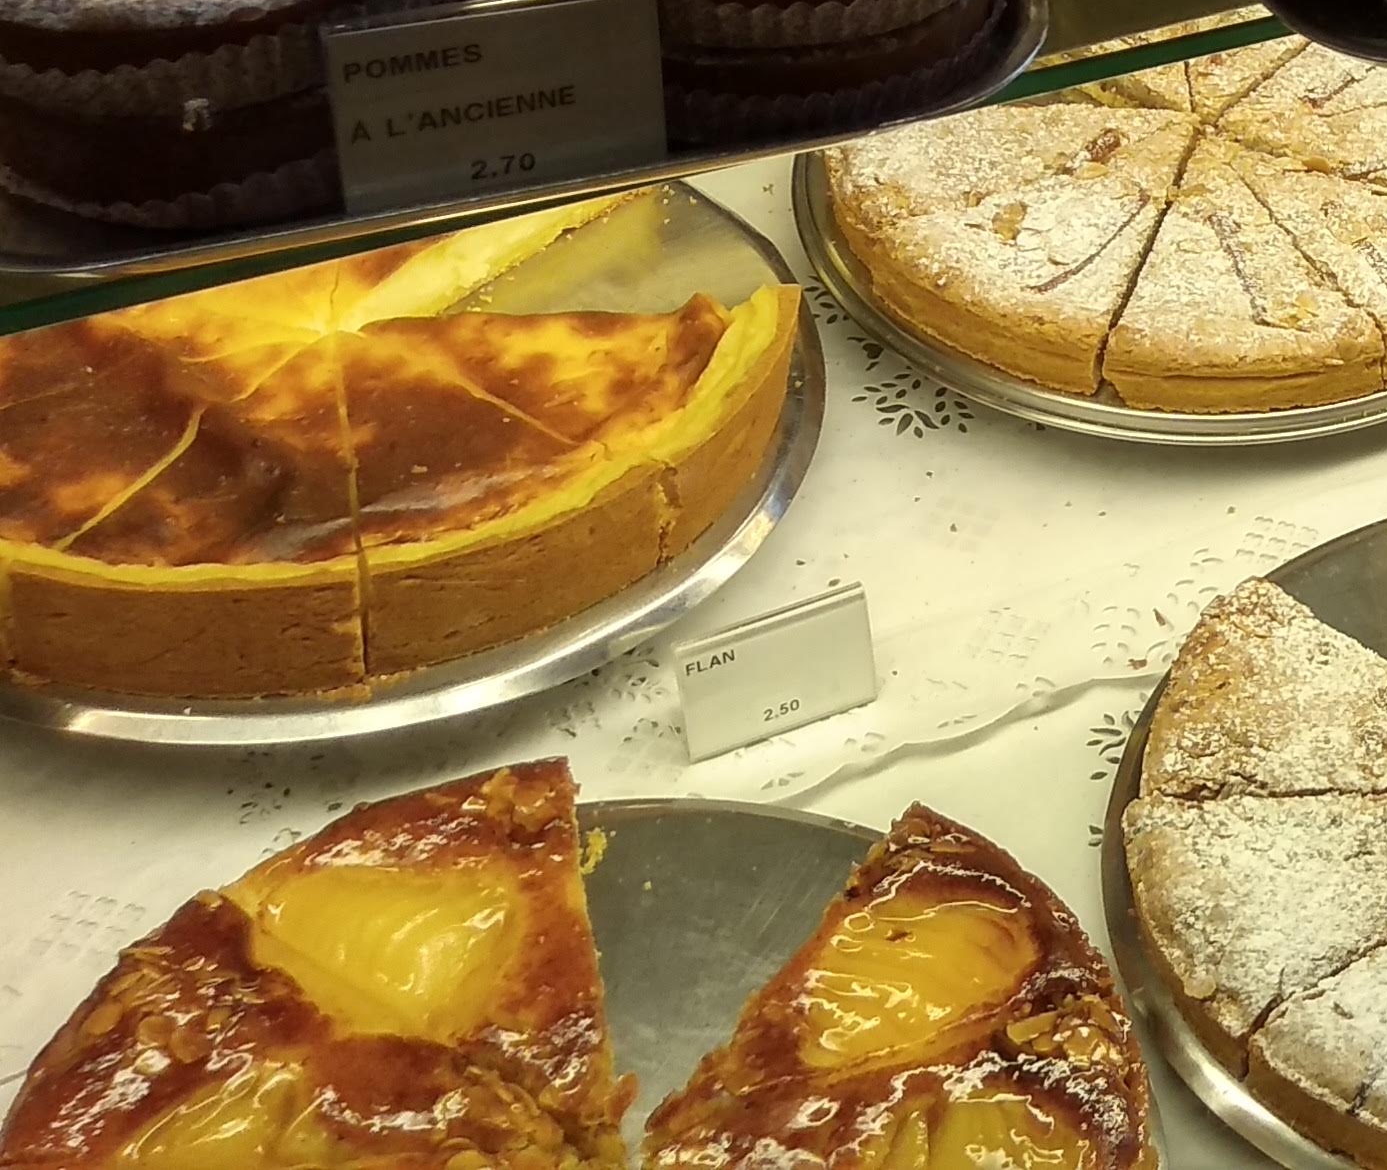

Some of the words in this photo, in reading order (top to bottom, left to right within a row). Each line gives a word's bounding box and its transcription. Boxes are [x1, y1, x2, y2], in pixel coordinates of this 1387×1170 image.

[343, 43, 483, 83] POMMES
[387, 85, 576, 139] L'ANCIENNE
[685, 649, 736, 677] FLAN
[763, 698, 800, 722] 2.50
